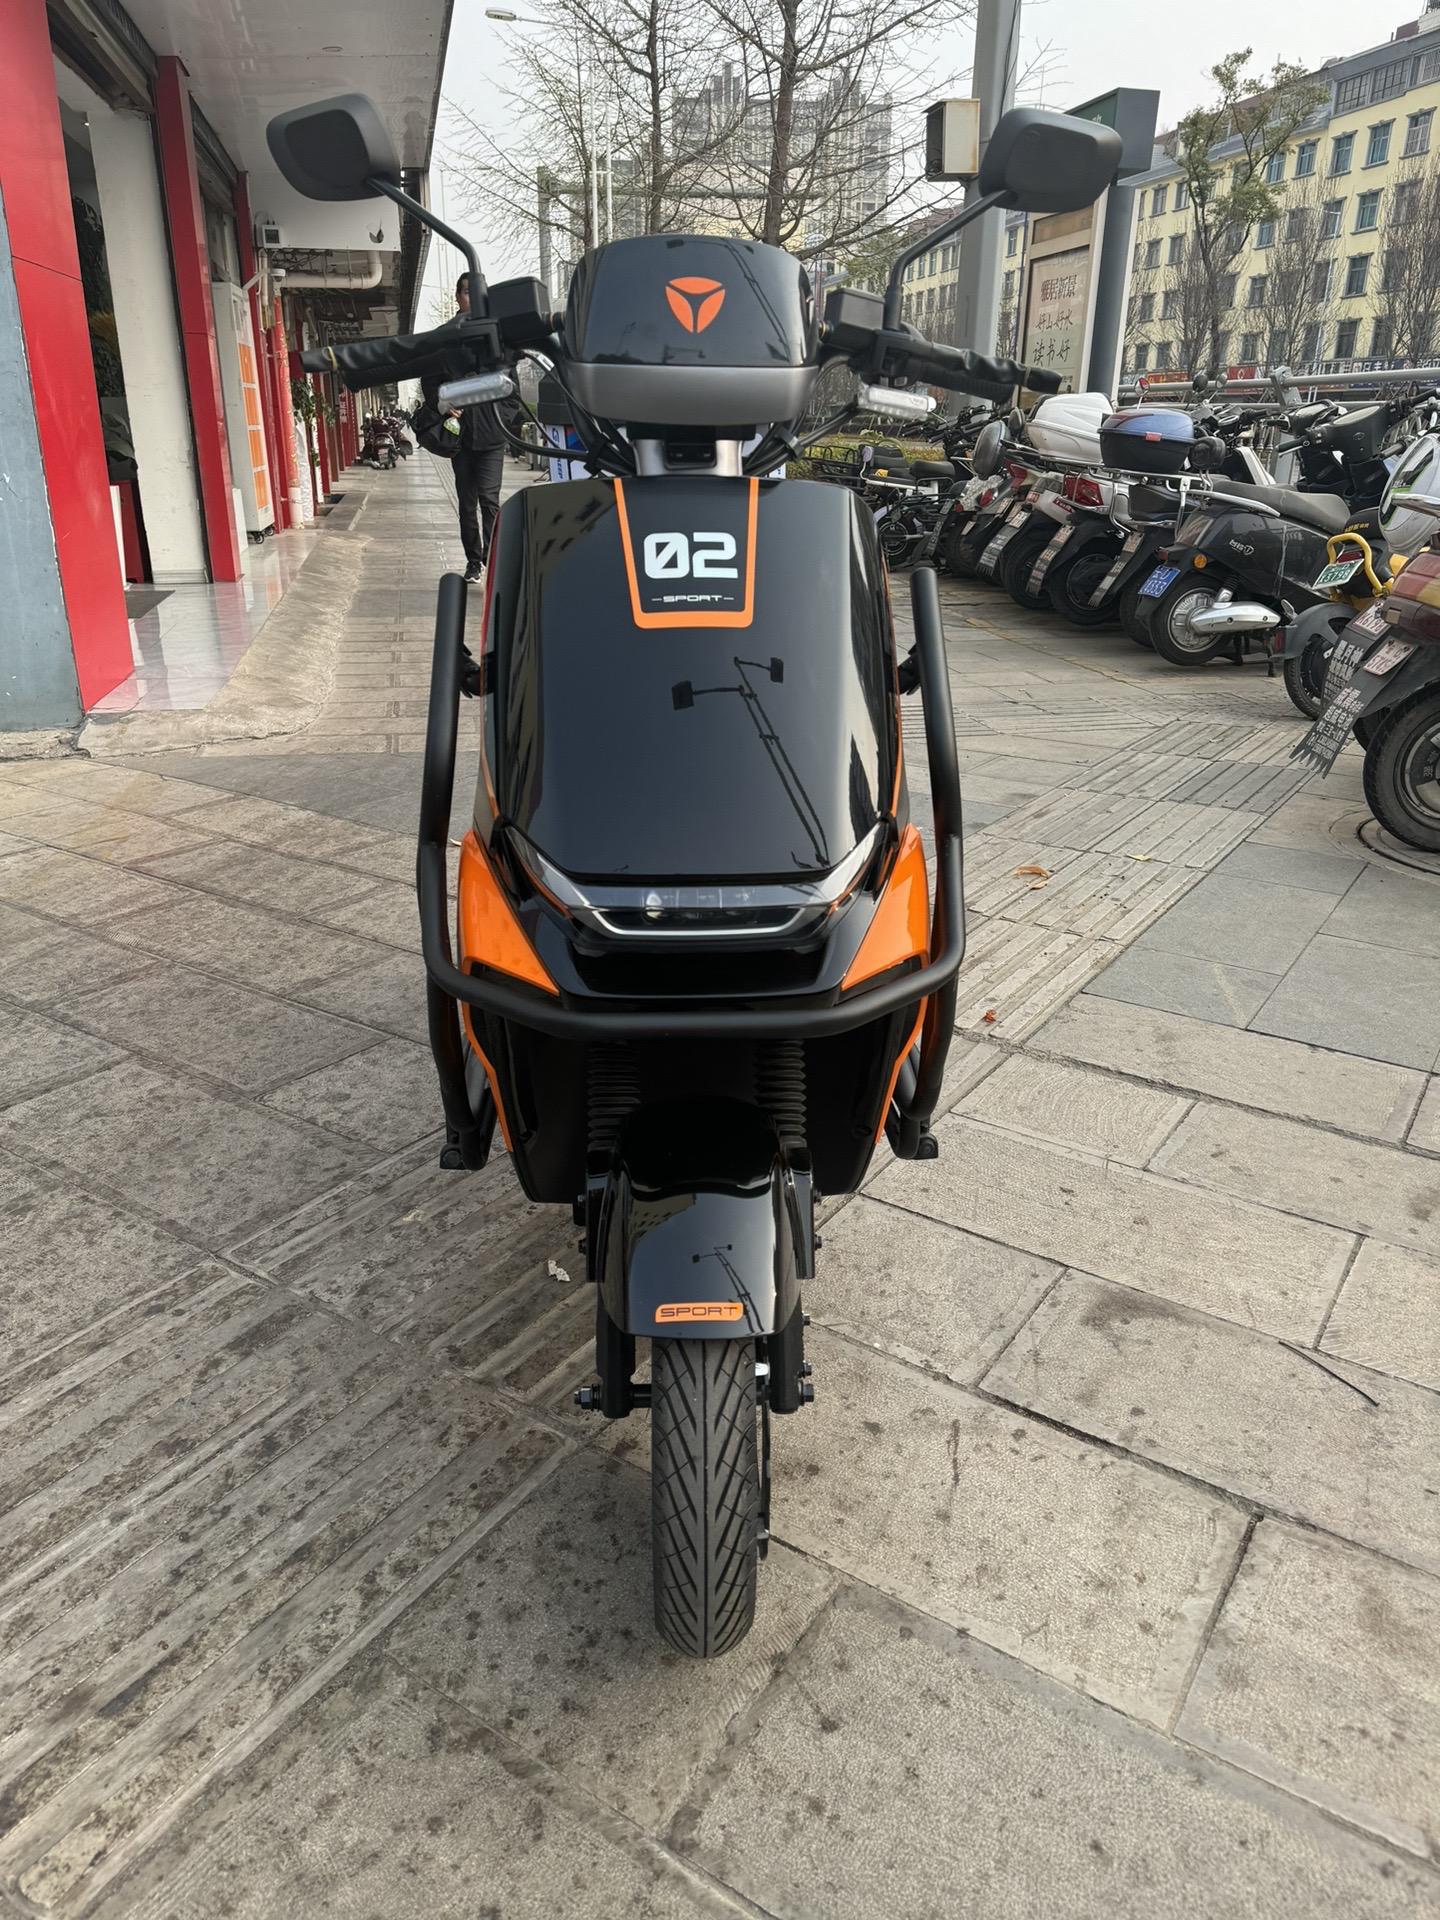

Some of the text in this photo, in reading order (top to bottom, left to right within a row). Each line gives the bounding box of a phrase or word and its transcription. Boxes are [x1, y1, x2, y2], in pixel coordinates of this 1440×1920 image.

[643, 531, 739, 579] 02
[663, 594, 723, 603] SPORT
[660, 1306, 738, 1318] SPORT
